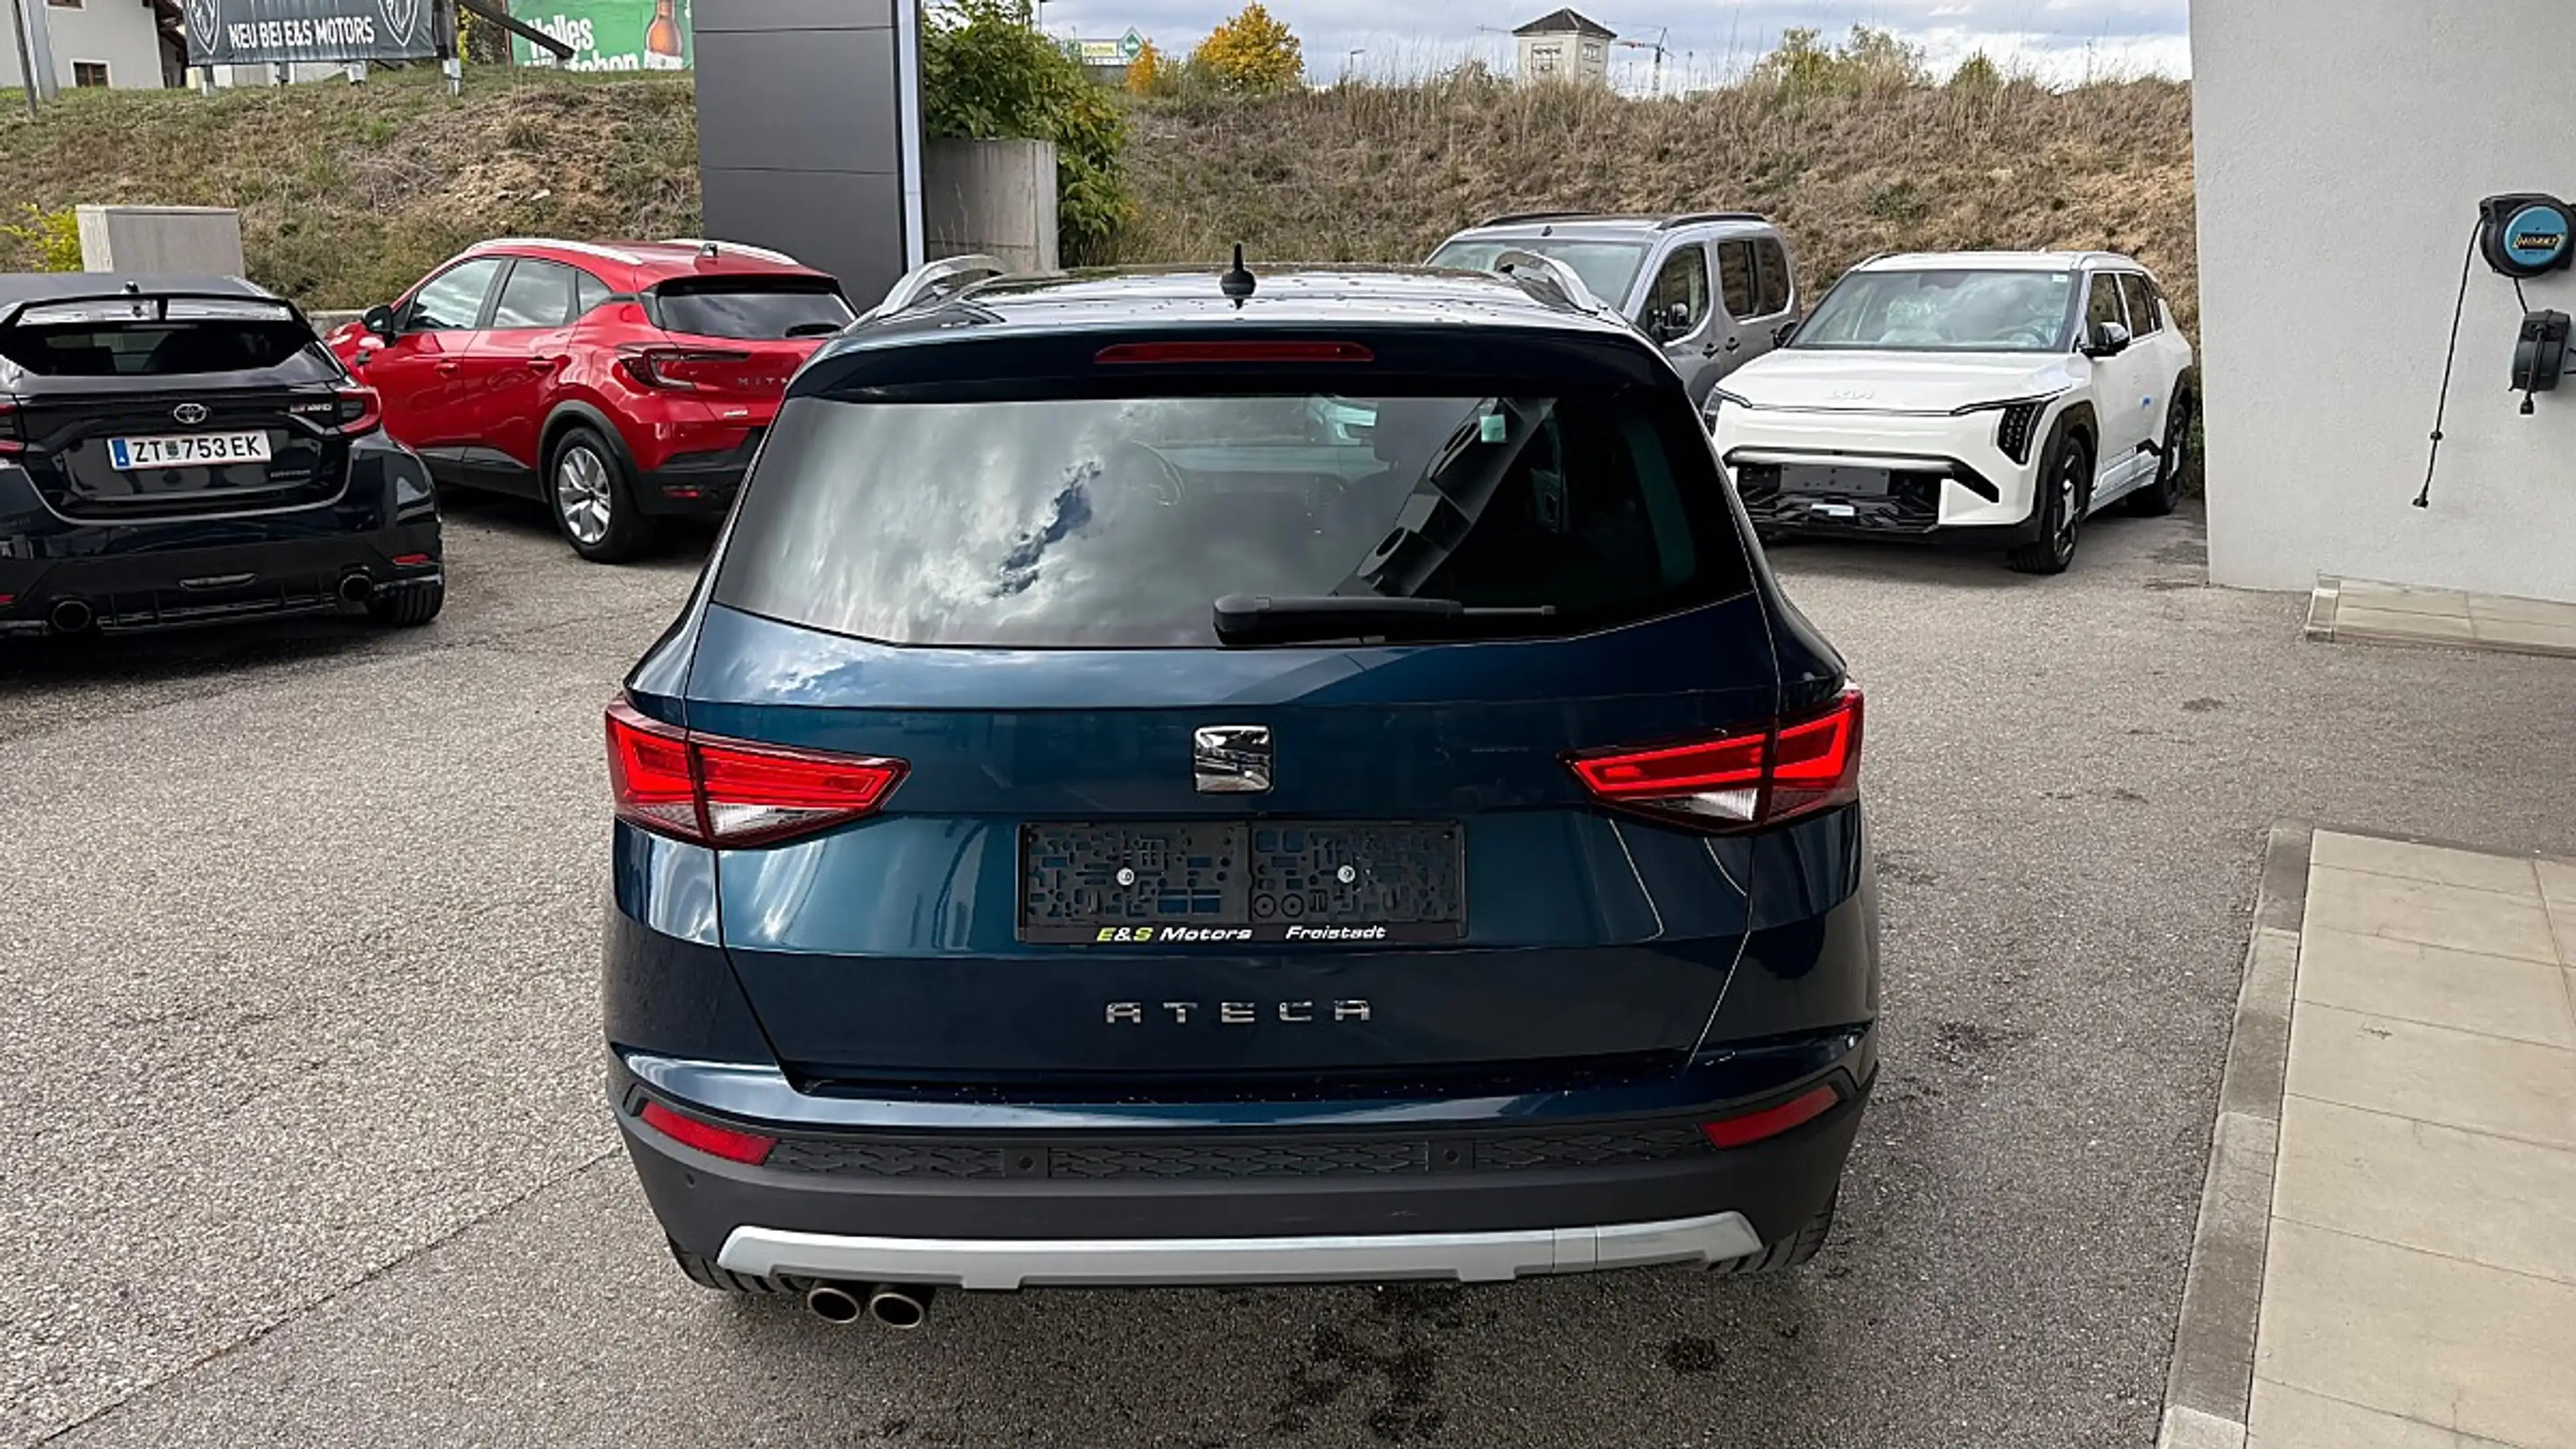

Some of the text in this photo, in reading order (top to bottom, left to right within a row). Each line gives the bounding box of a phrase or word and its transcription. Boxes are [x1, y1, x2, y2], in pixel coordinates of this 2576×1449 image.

[227, 15, 375, 49] NEU BEI E&S MOTORS
[133, 435, 261, 462] ZT 753 EK
[1096, 926, 1154, 942] E&S
[1159, 926, 1253, 942] Motors
[1106, 999, 1371, 1024] ATECA
